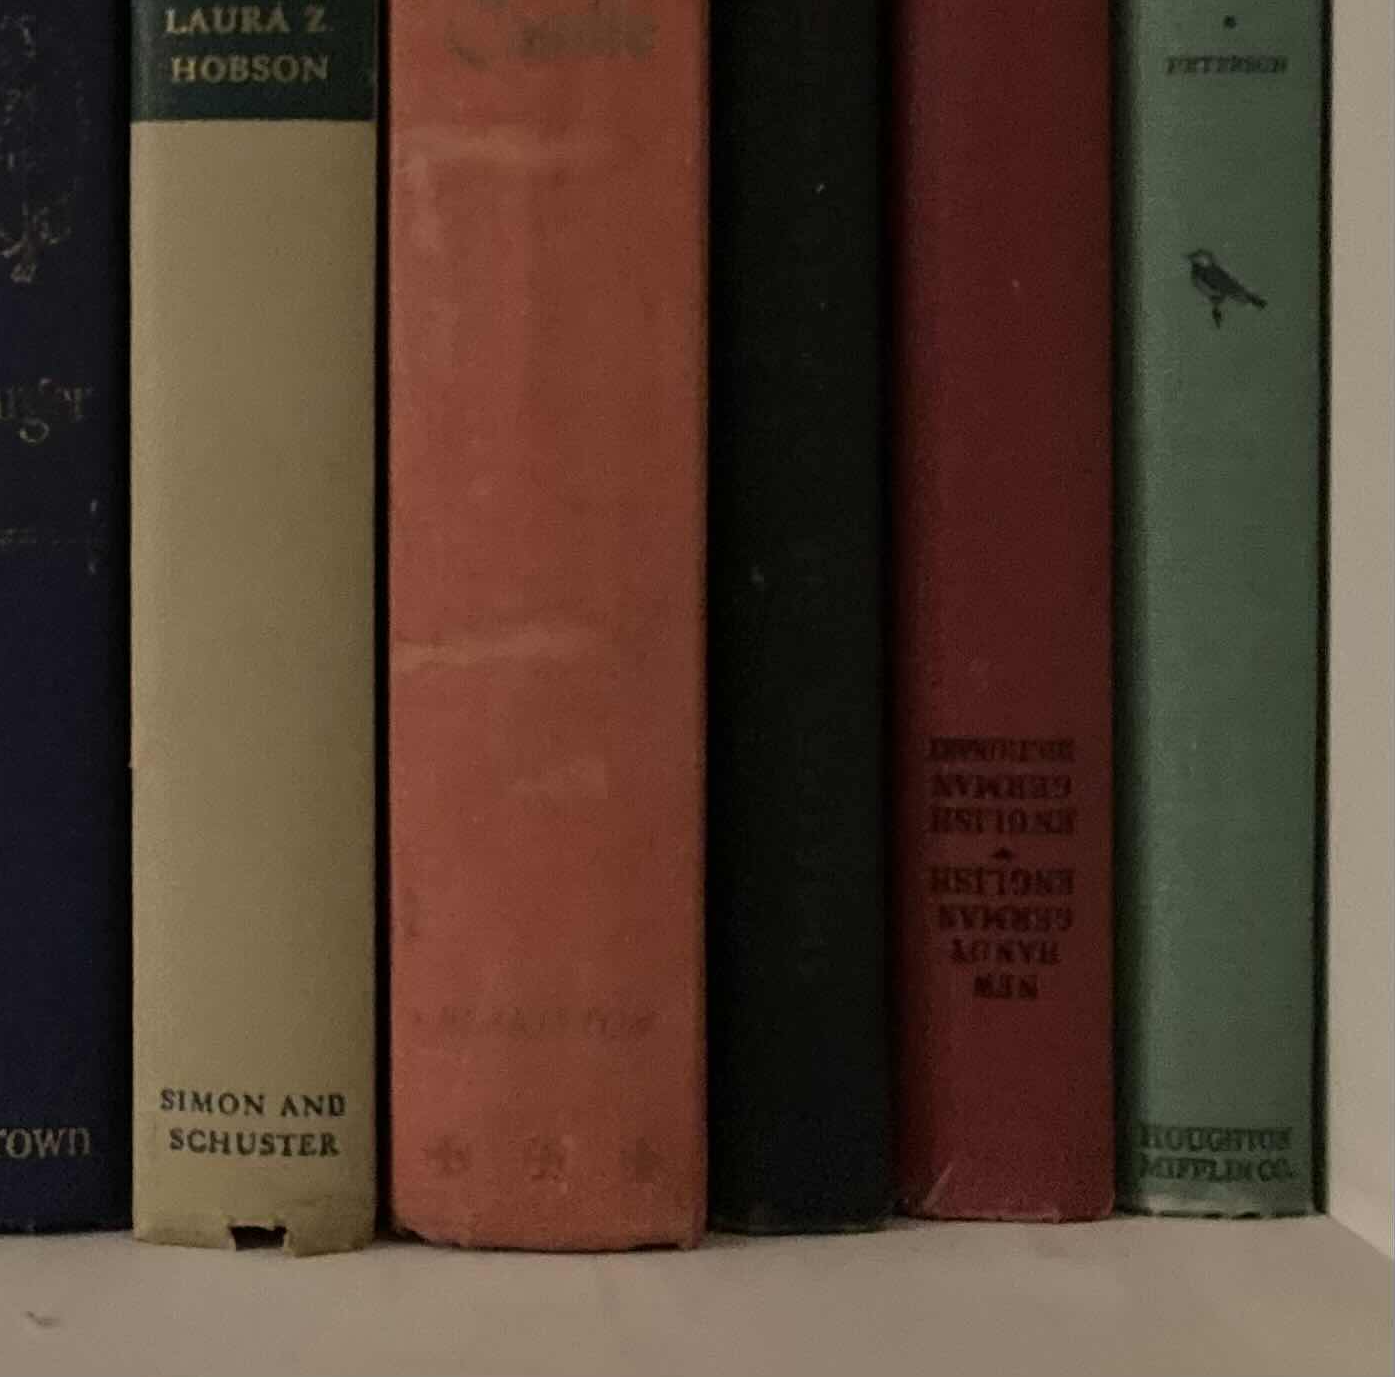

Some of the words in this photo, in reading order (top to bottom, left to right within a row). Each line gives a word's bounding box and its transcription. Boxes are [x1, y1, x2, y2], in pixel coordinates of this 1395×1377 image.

[163, 2, 291, 35] LAURA
[170, 53, 330, 85] HOBSON
[932, 773, 1073, 800] GERMAN
[159, 1087, 266, 1116] SIMON
[279, 1091, 348, 1118] AND
[168, 1126, 342, 1158] SCHUSTER
